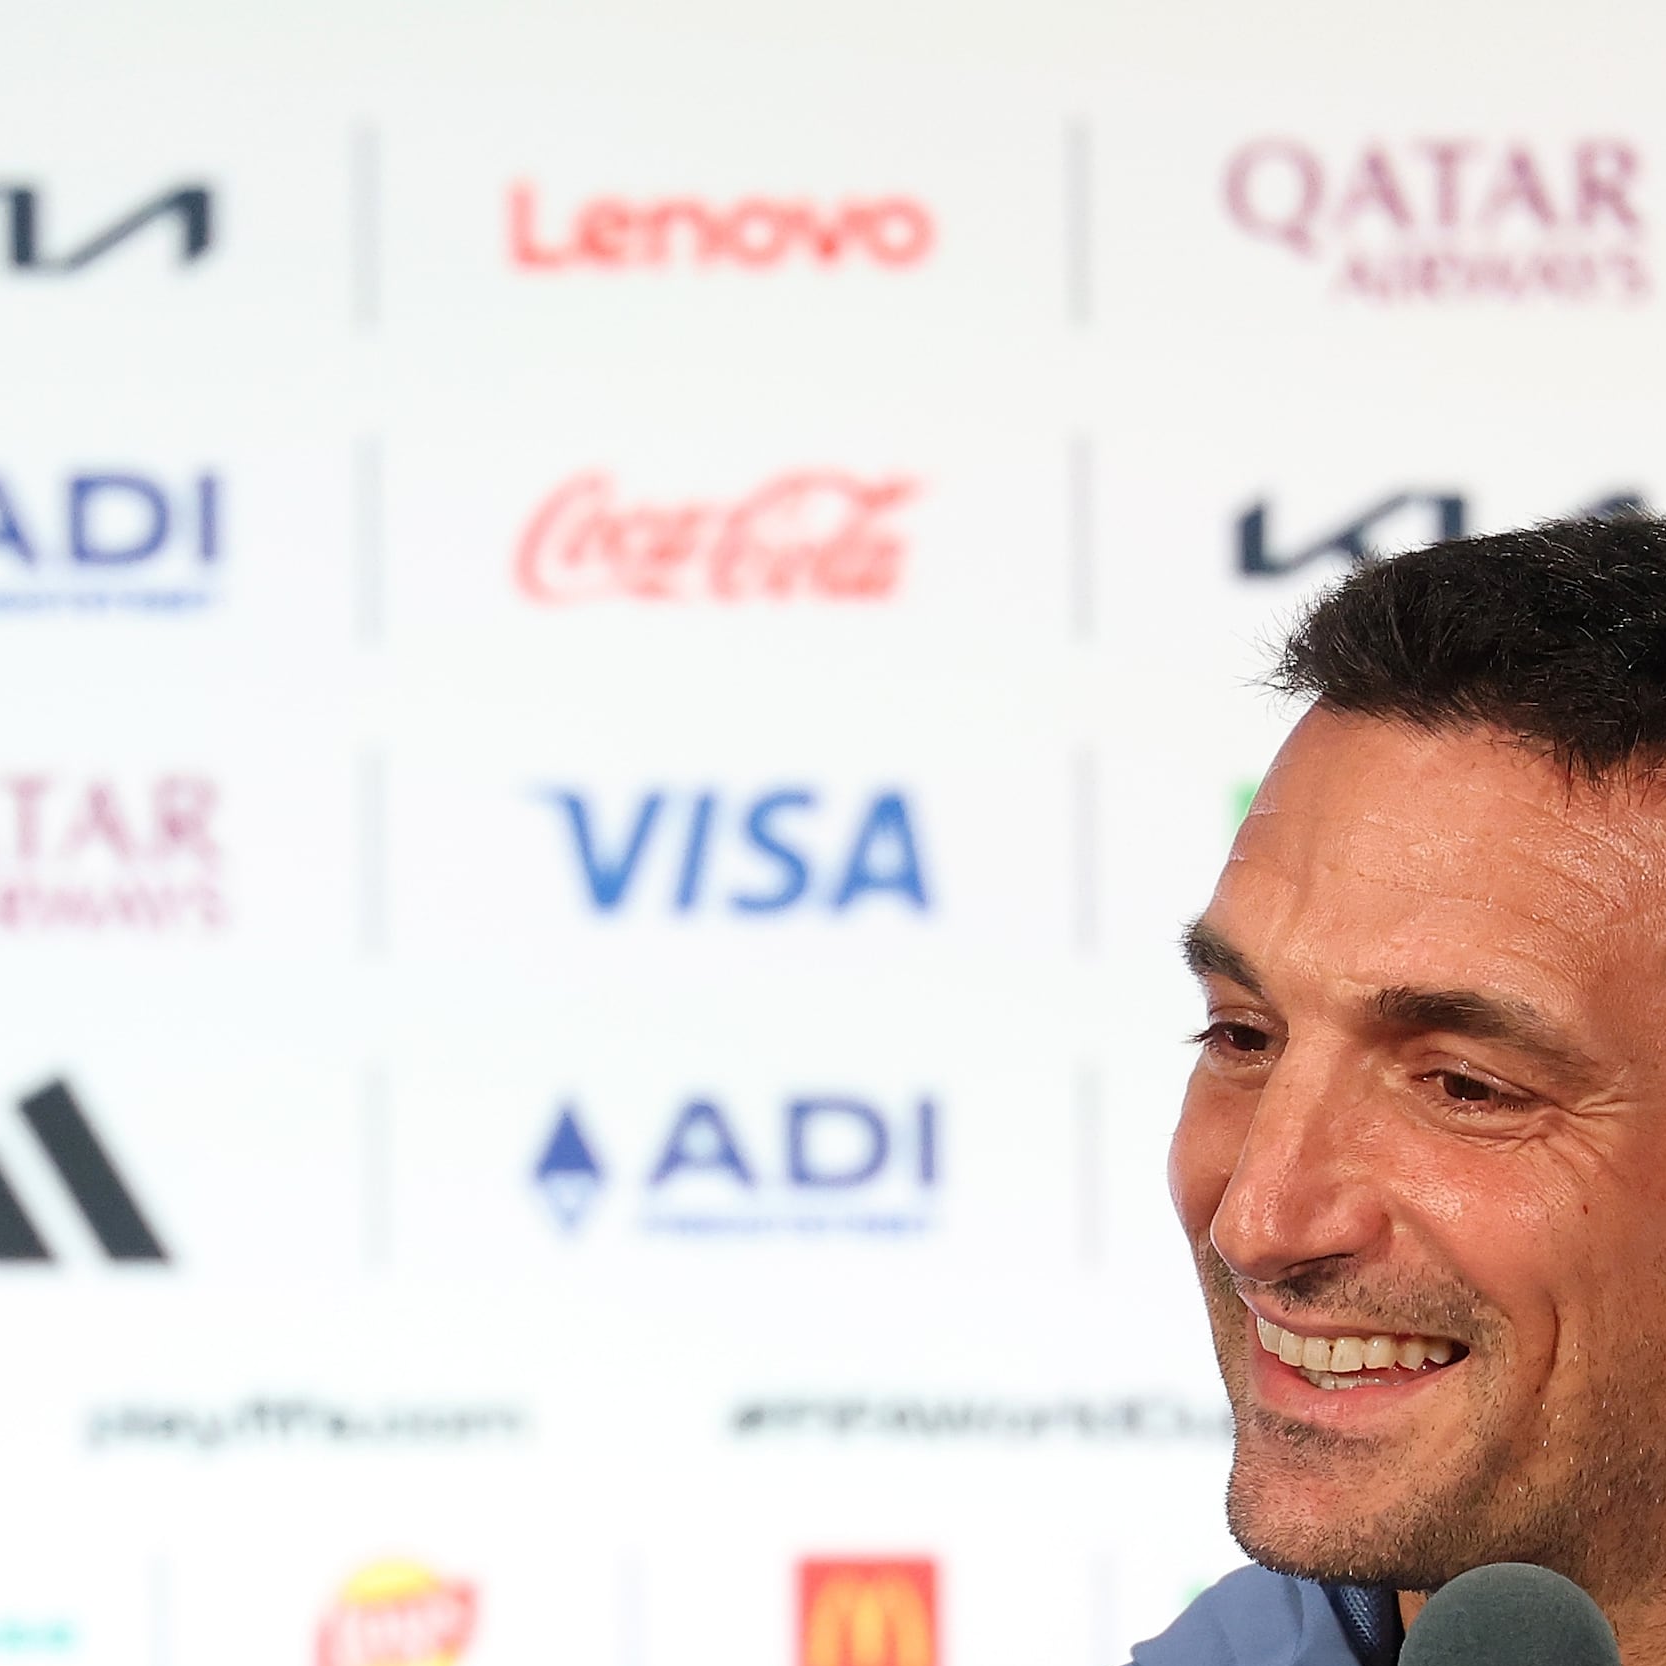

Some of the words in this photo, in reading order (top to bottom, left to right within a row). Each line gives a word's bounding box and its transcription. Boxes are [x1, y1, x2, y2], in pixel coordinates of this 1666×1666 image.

[507, 182, 937, 273] Lenovo
[1221, 137, 1645, 258] QATAR
[1336, 253, 1652, 304] AIRWAYS
[542, 784, 935, 919] VISA
[645, 1092, 943, 1190] ADI
[723, 1391, 1232, 1446] #FIFAWorldCu
